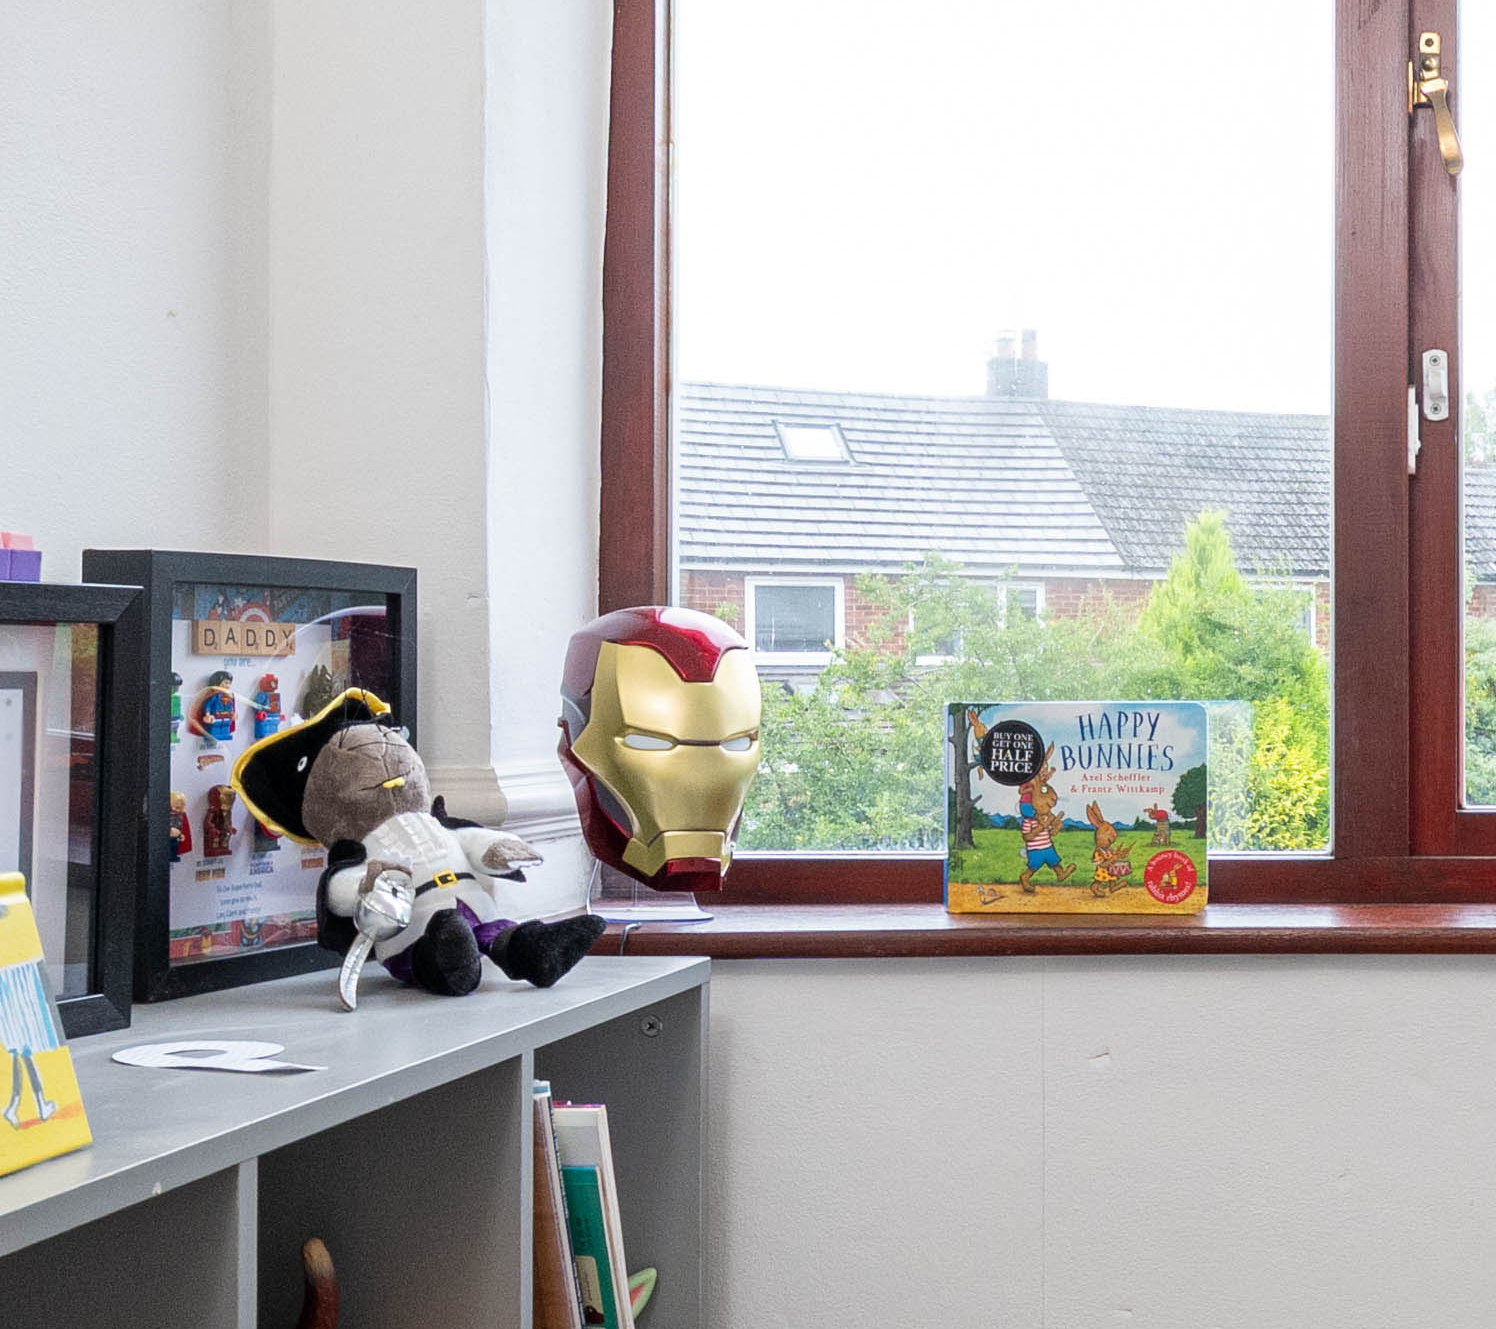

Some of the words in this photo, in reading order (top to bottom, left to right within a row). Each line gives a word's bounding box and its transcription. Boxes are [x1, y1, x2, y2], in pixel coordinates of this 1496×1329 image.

[204, 627, 295, 648] DADDY
[1077, 710, 1161, 742] HAPPY
[993, 731, 1012, 740] BUY
[1013, 733, 1034, 742] ONE
[992, 740, 1012, 748] GET
[1012, 741, 1034, 750] ONE
[991, 748, 1034, 762] HALF
[1061, 744, 1175, 772] BUNNIES
[990, 760, 1033, 774] PRICE
